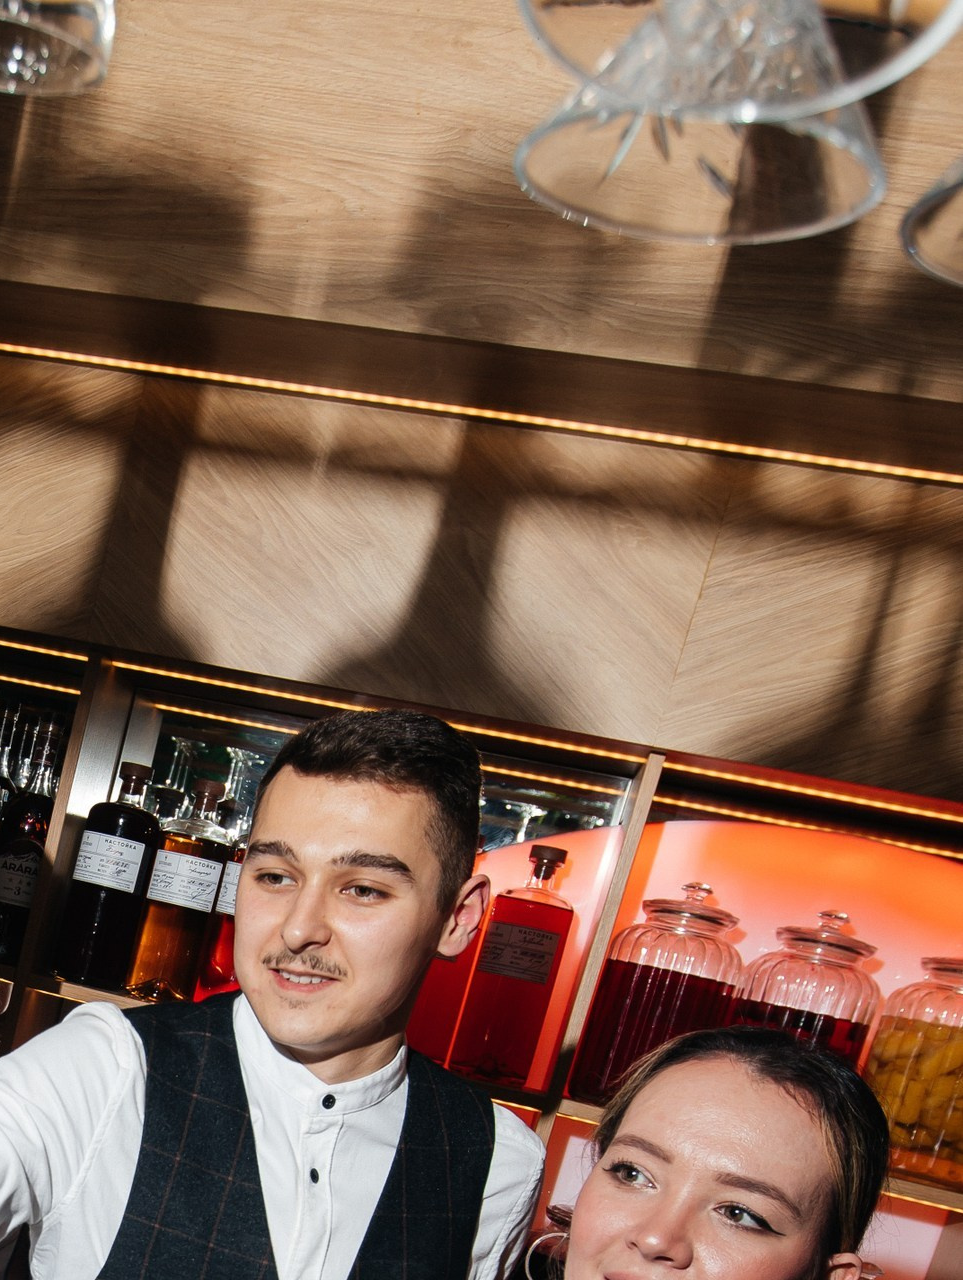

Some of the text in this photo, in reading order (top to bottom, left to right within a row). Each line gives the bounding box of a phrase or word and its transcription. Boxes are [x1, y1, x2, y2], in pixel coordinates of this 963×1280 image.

[104, 839, 137, 850] НАСТОЙКА
[185, 859, 216, 870] НАСТОЙКА
[14, 886, 21, 896] 3
